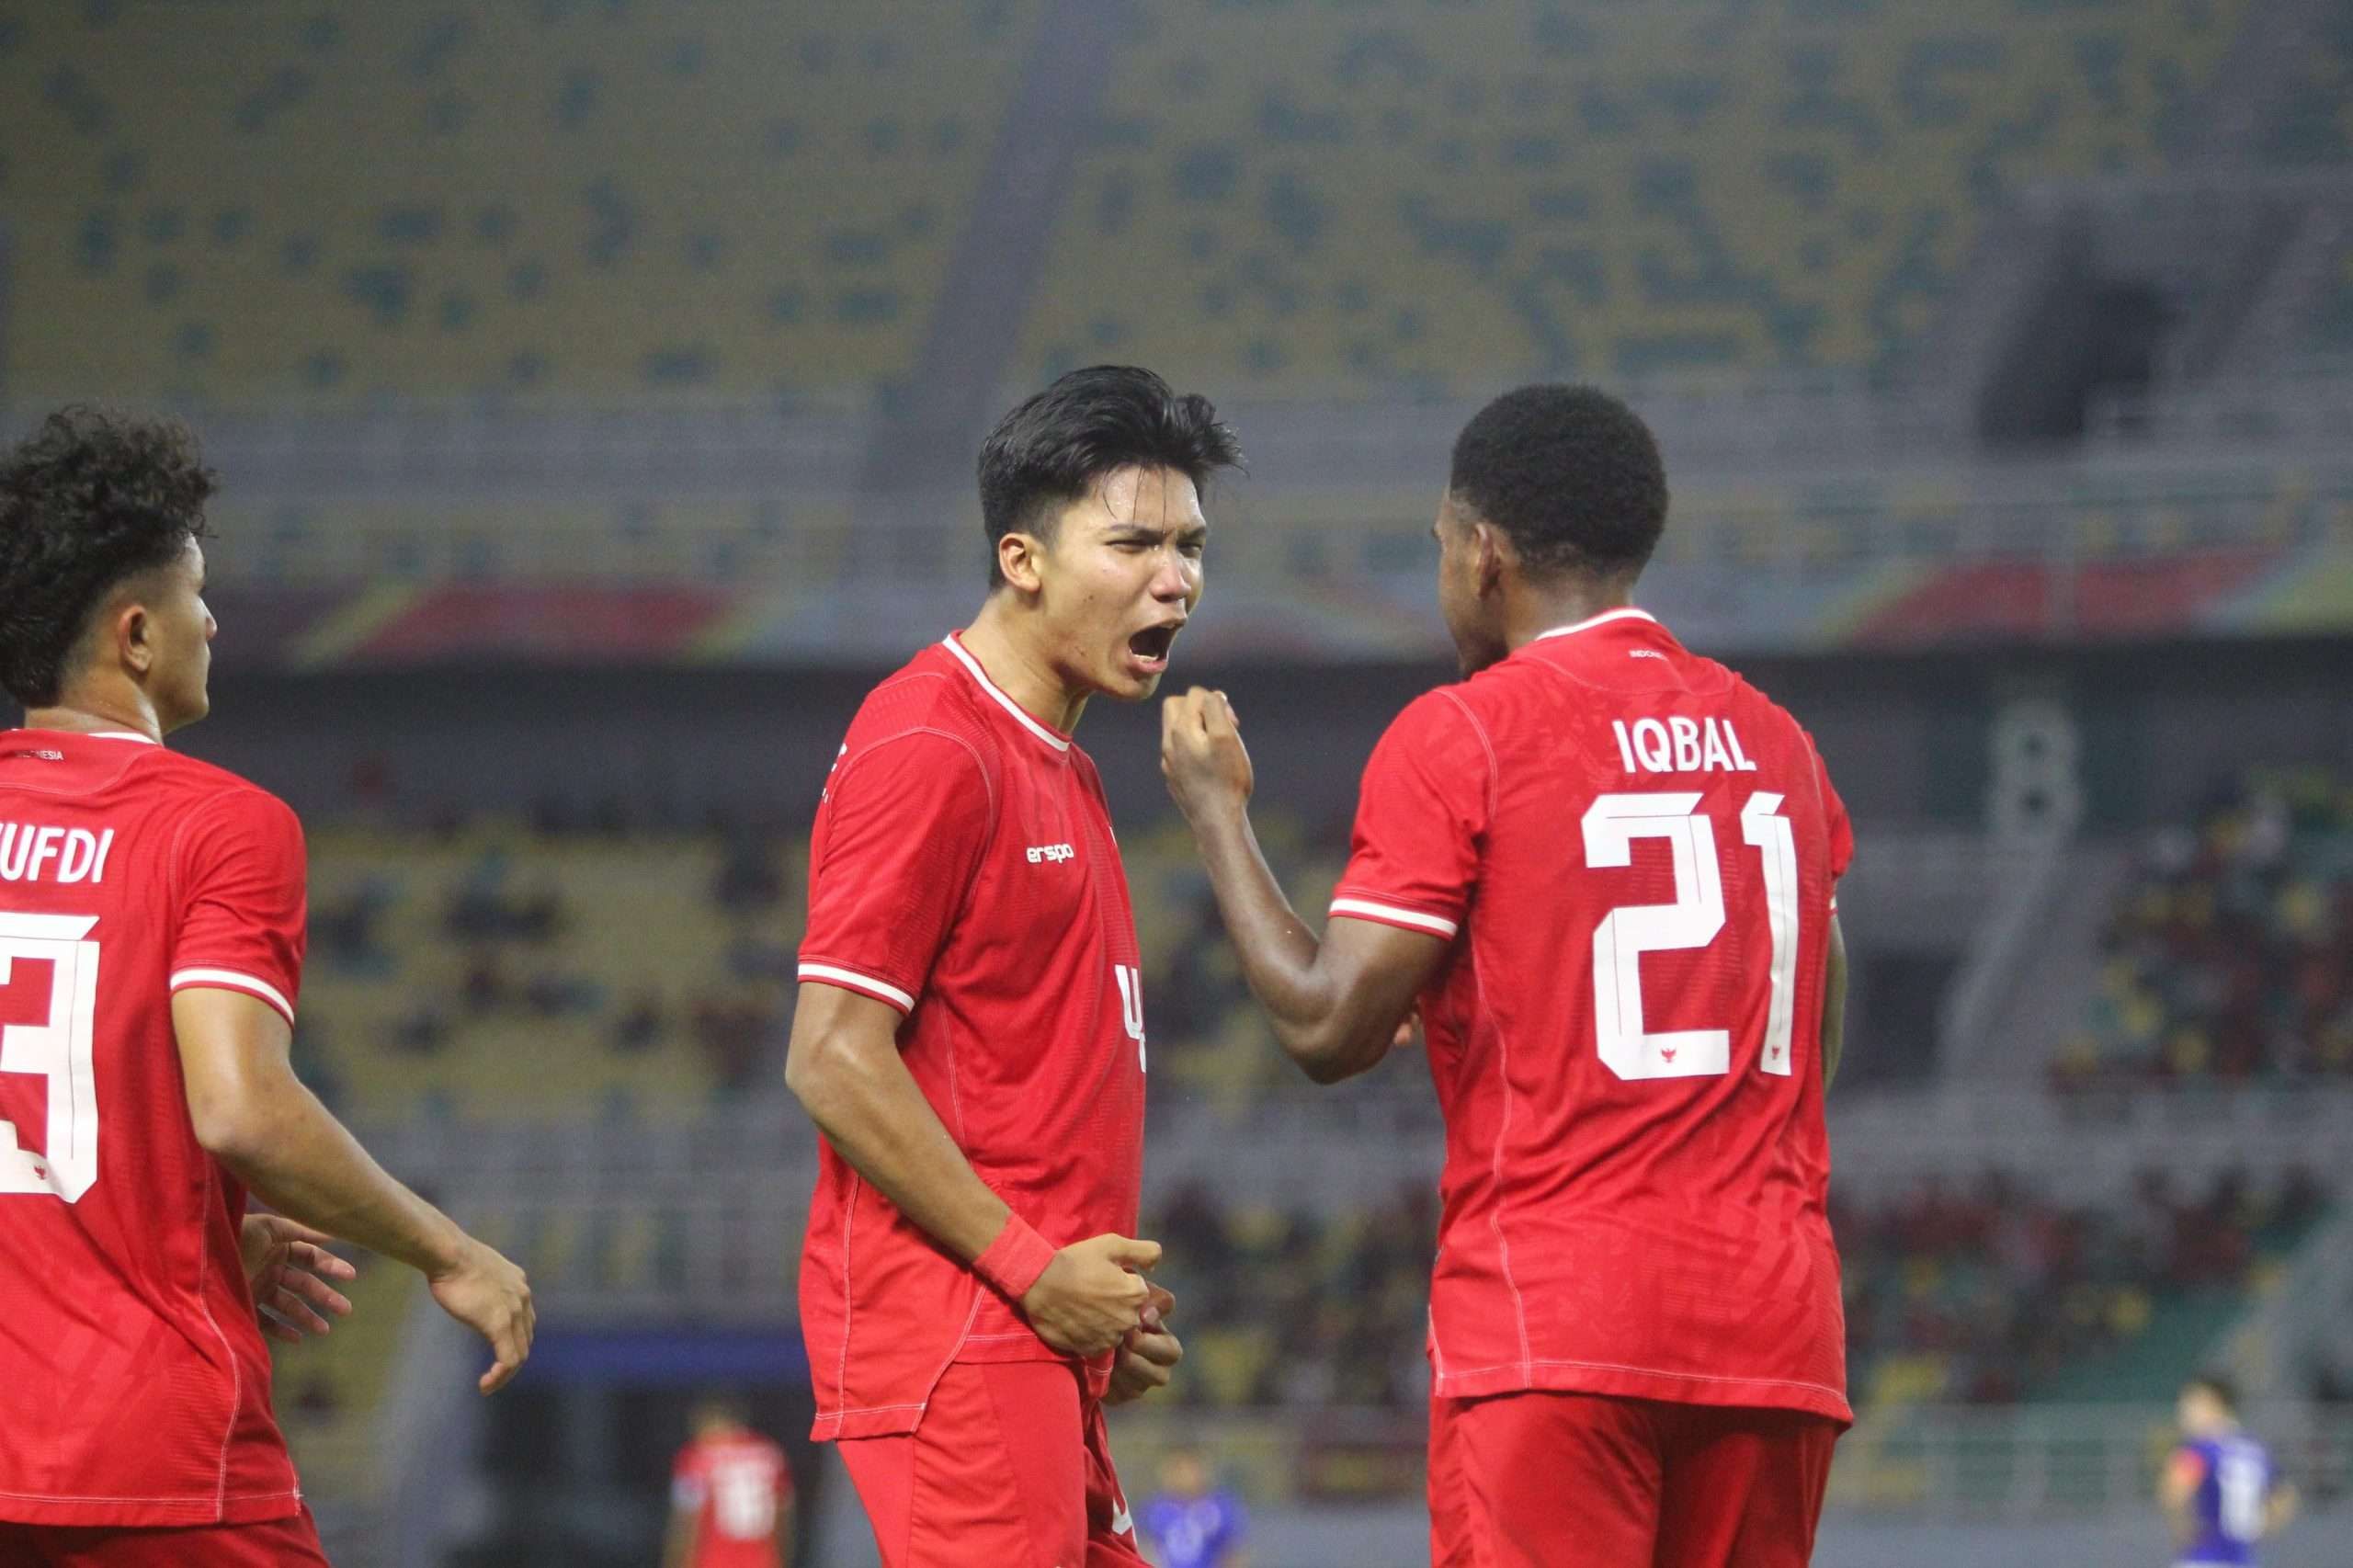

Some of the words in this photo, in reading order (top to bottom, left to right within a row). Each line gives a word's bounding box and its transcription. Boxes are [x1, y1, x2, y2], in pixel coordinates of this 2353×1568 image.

[1612, 717, 1756, 773] IQBAL
[0, 822, 115, 883] UFDI
[1027, 844, 1074, 863] erspo
[1581, 791, 1799, 1081] 21
